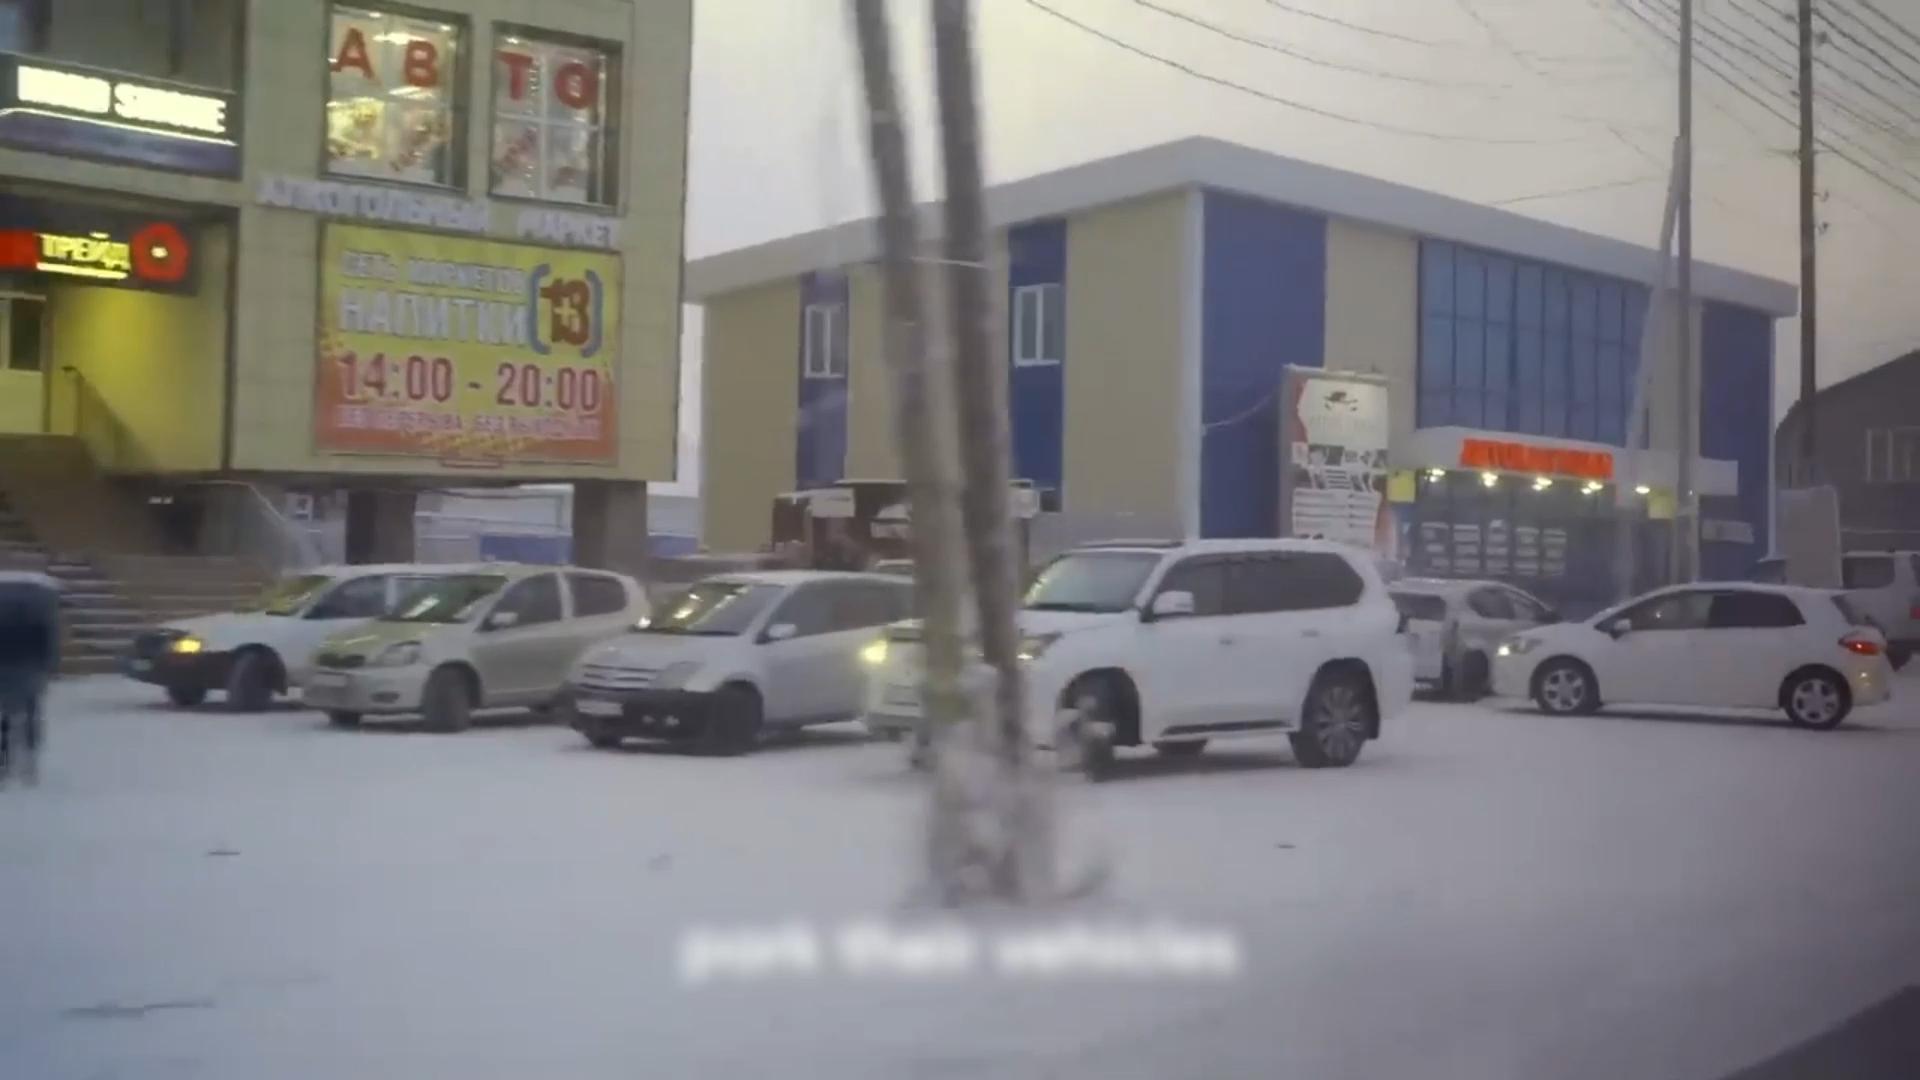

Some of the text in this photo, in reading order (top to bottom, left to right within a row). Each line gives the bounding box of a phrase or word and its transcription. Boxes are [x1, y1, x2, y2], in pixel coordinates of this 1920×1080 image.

[338, 286, 530, 347] НАПИТКИ
[337, 352, 454, 403] 14:00
[496, 361, 601, 412] 20:00
